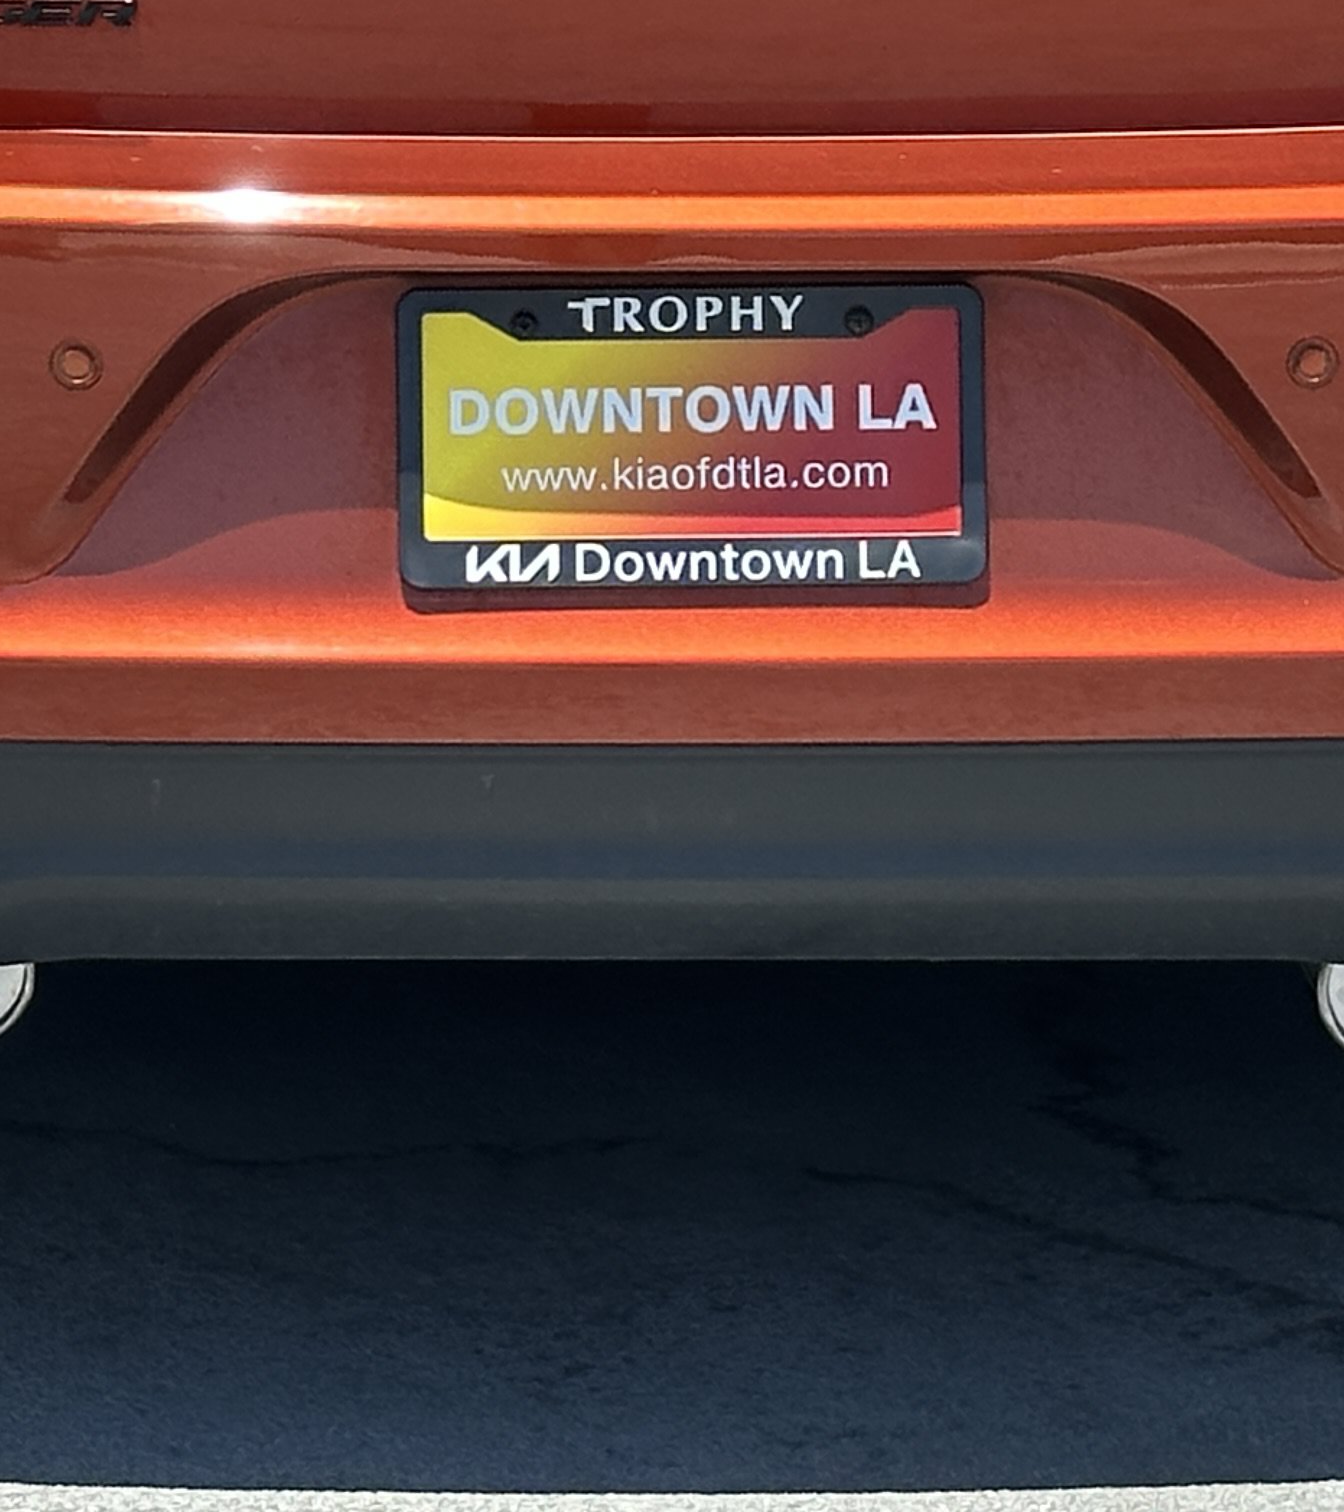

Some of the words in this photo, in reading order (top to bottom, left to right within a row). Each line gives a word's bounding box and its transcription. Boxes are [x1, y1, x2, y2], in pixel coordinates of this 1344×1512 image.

[567, 295, 804, 333] TROPHY
[448, 384, 834, 436] DOWNTOWN
[858, 383, 937, 430] LA
[501, 456, 889, 493] www.kiaofdtla.com
[465, 544, 560, 583] KIA
[575, 541, 844, 583] Downtown
[858, 540, 921, 580] LA
